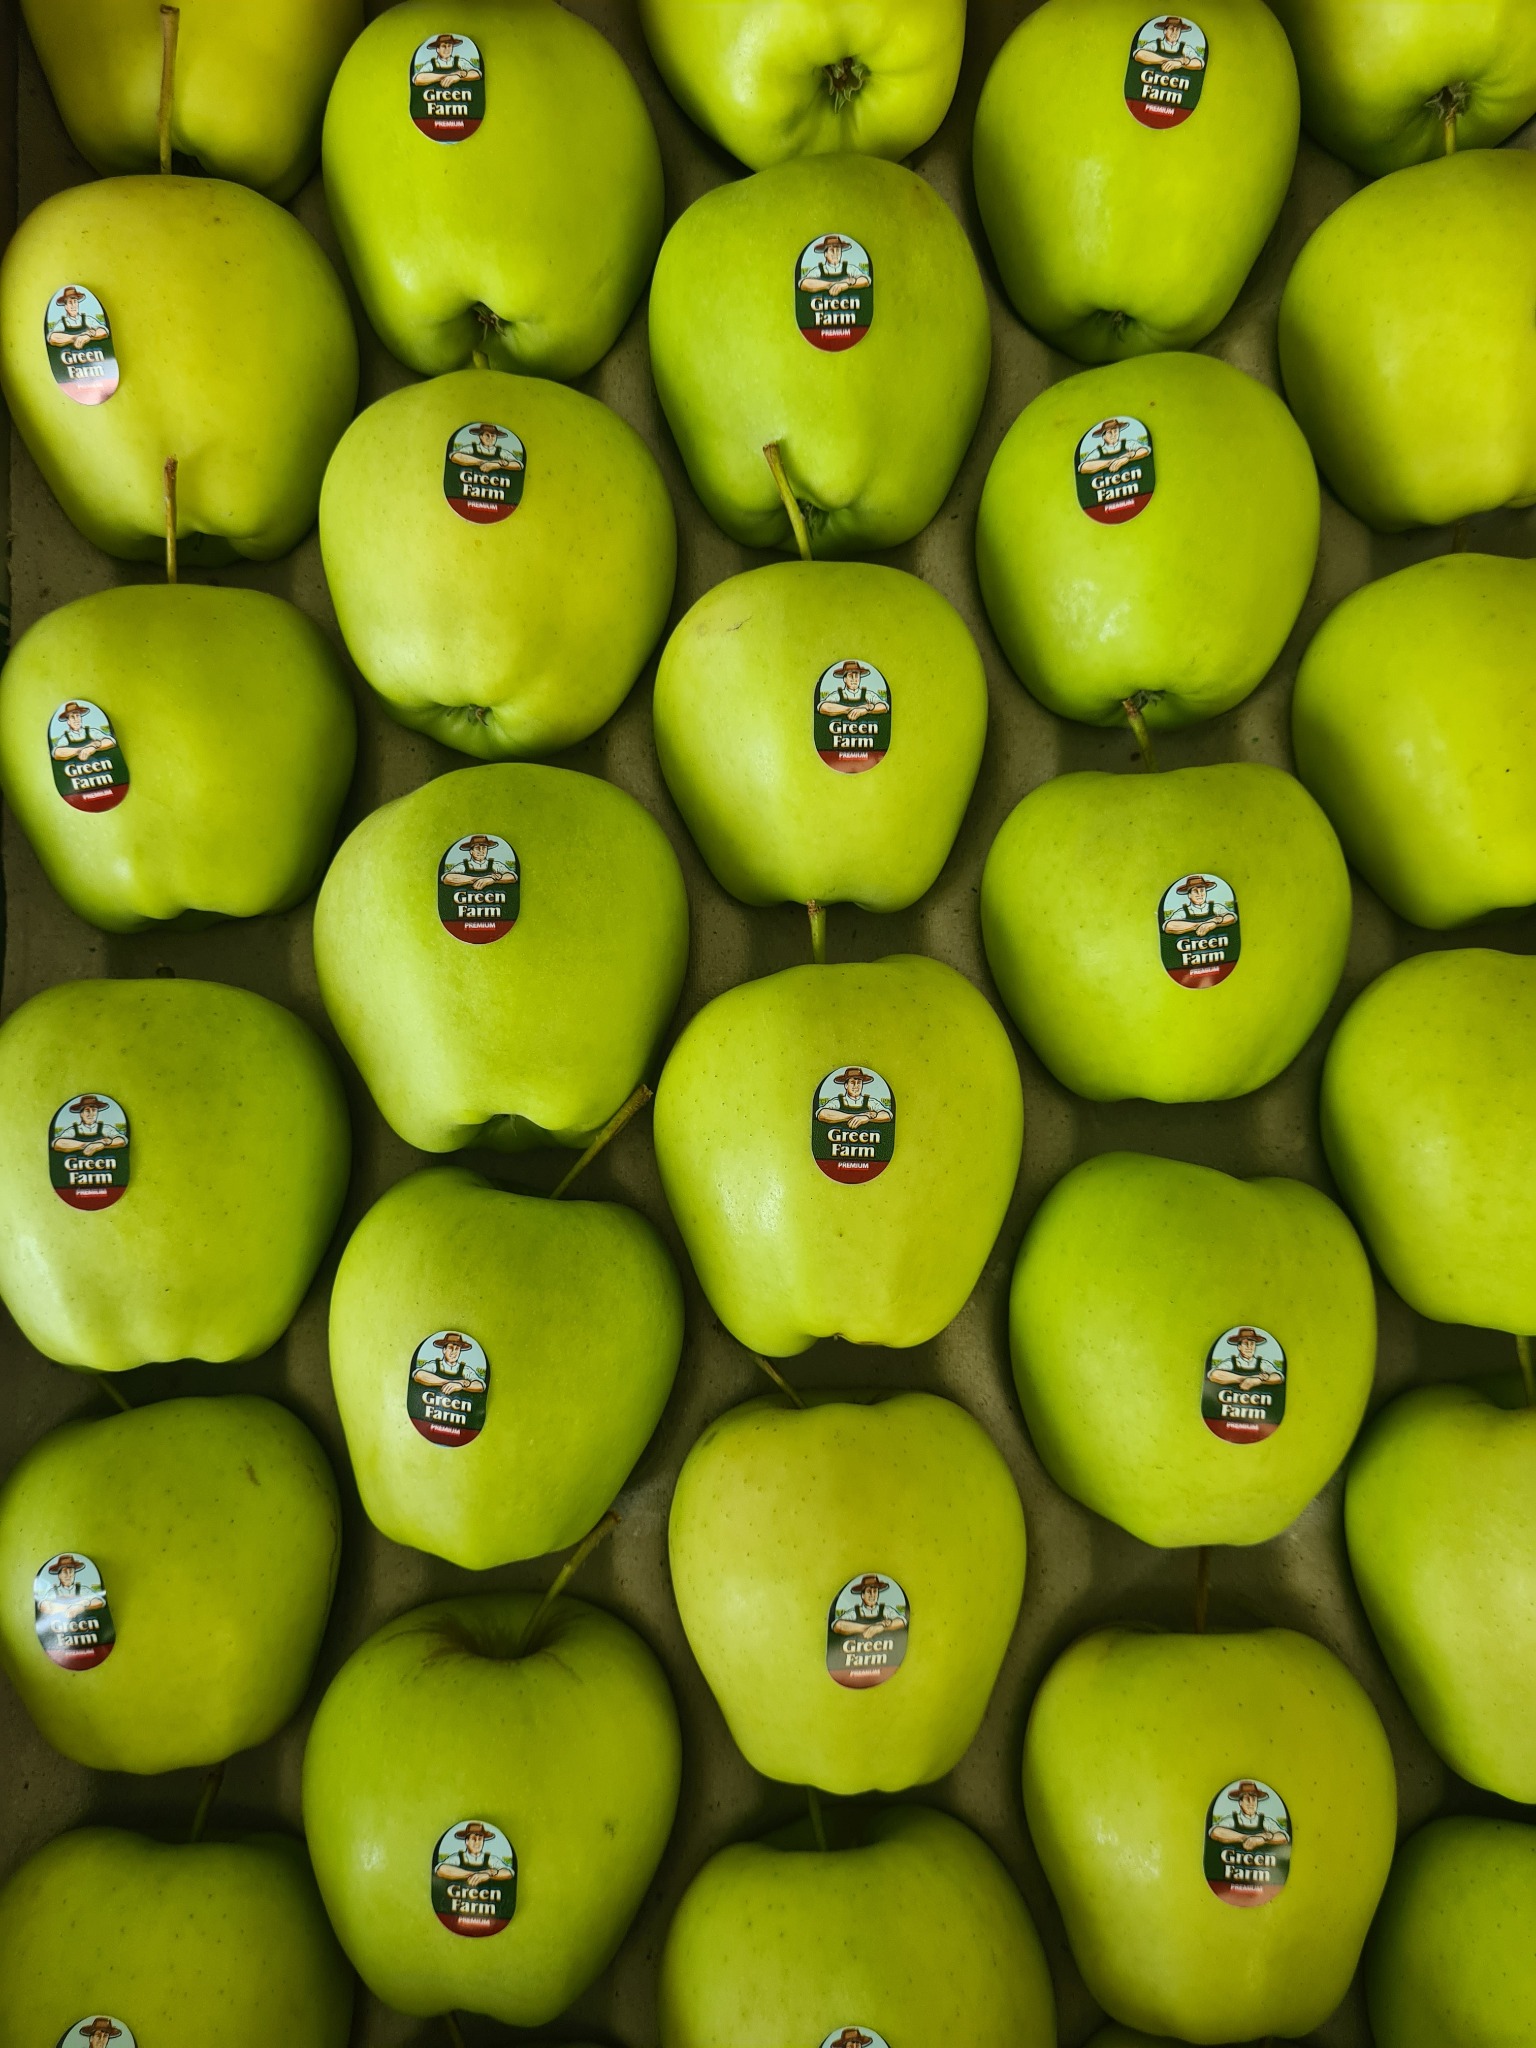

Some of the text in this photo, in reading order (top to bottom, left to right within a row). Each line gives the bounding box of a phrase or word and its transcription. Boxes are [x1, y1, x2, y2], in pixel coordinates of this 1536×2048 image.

[1140, 71, 1189, 91] Green
[423, 89, 472, 101] Green
[1142, 85, 1182, 104] Farm
[427, 103, 468, 116] Farm
[1145, 104, 1174, 115] PREMIUM
[810, 297, 860, 310] Green
[815, 311, 856, 325] Farm
[61, 348, 103, 363] Green
[67, 362, 104, 379] Farm
[459, 470, 511, 488] Green
[1091, 468, 1142, 488] Green
[463, 484, 505, 500] Farm
[1096, 482, 1139, 502] Farm
[467, 502, 498, 510] PREMIUM
[829, 721, 879, 734] Green
[833, 736, 873, 749] Farm
[65, 759, 113, 777] Green
[71, 771, 113, 790] Farm
[453, 891, 506, 904] Green
[458, 905, 501, 918] Farm
[1176, 936, 1228, 952] Green
[1182, 950, 1224, 966] Farm
[827, 1129, 880, 1143] Green
[831, 1143, 875, 1158] Farm
[64, 1157, 116, 1170] Green
[69, 1171, 113, 1185] Farm
[422, 1392, 472, 1412] Green
[1218, 1390, 1272, 1405] Green
[425, 1407, 466, 1425] Farm
[1221, 1404, 1266, 1419] Farm
[50, 1618, 100, 1633] Green
[57, 1632, 98, 1648] Farm
[842, 1638, 893, 1653] Green
[845, 1653, 887, 1666] Farm
[1221, 1850, 1276, 1867] Green
[1225, 1866, 1270, 1881] Farm
[446, 1885, 501, 1901] Green
[451, 1899, 496, 1915] Farm
[458, 1917, 490, 1925] PREMIUM
